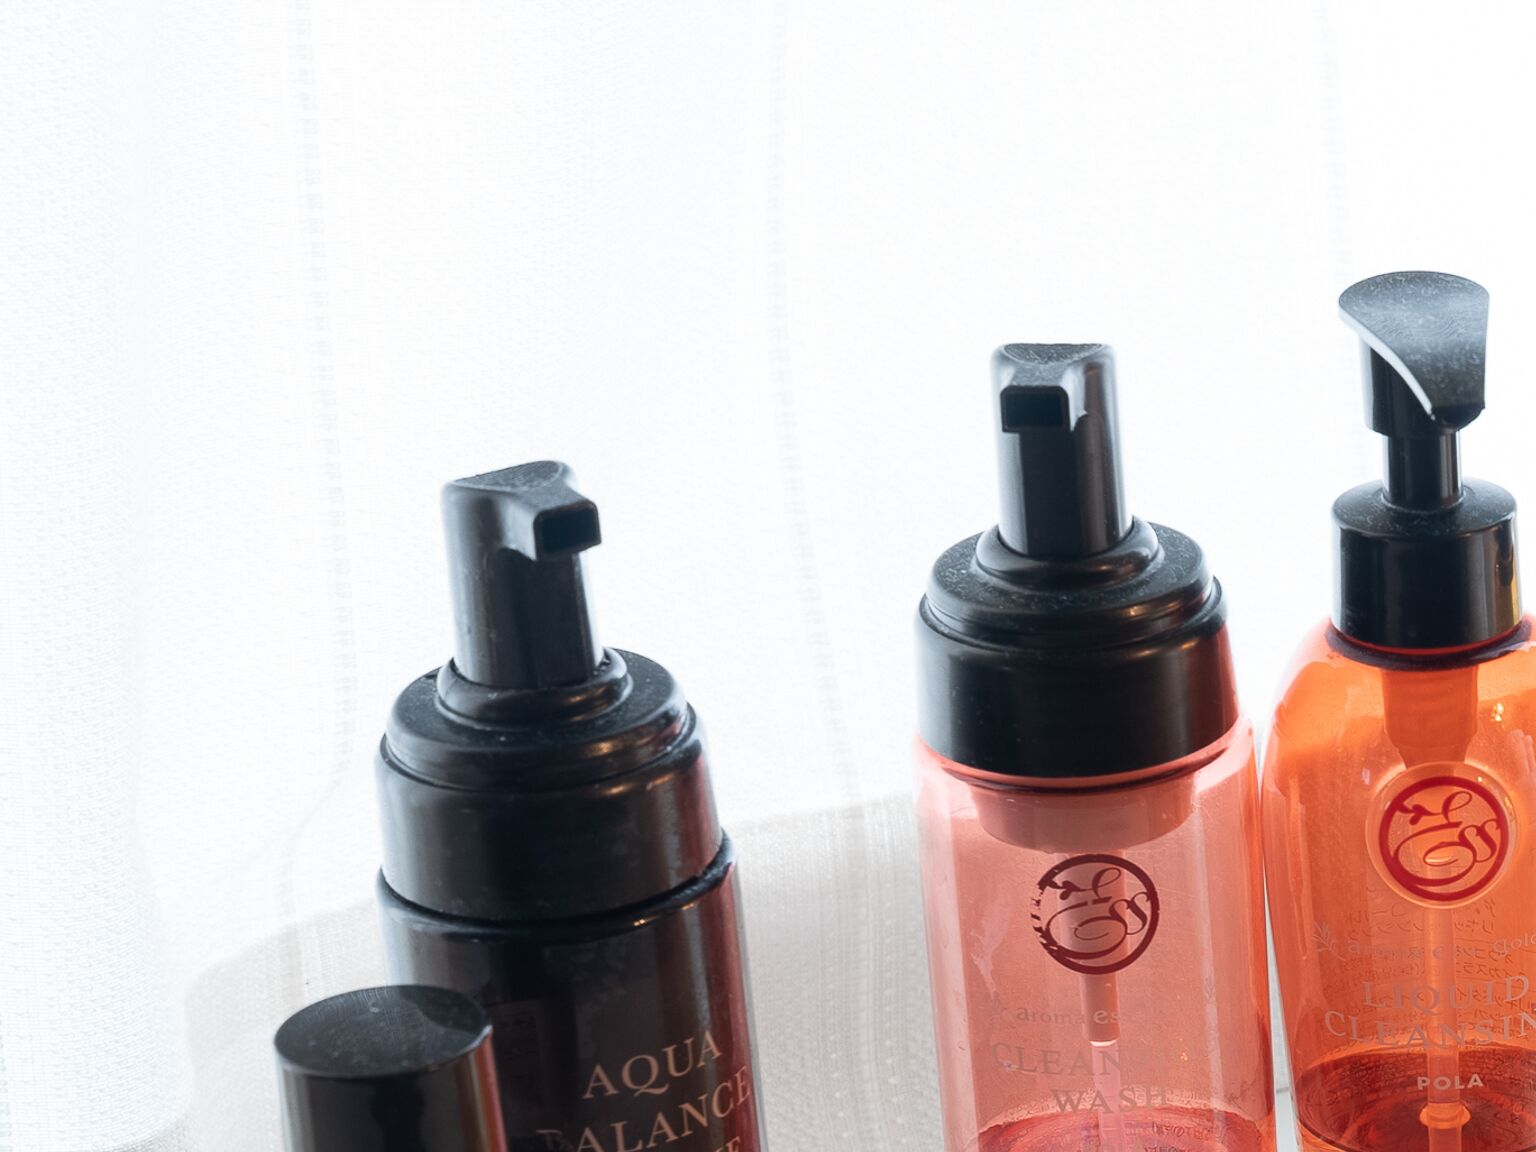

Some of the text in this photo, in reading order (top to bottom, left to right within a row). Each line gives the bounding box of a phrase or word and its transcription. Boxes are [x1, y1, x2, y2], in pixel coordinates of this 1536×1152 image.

[1362, 975, 1531, 1016] LIQUID
[1016, 1005, 1085, 1025] aroma
[582, 1030, 722, 1099] AQUA
[1416, 1073, 1484, 1091] POLA
[1049, 1087, 1169, 1116] WASH
